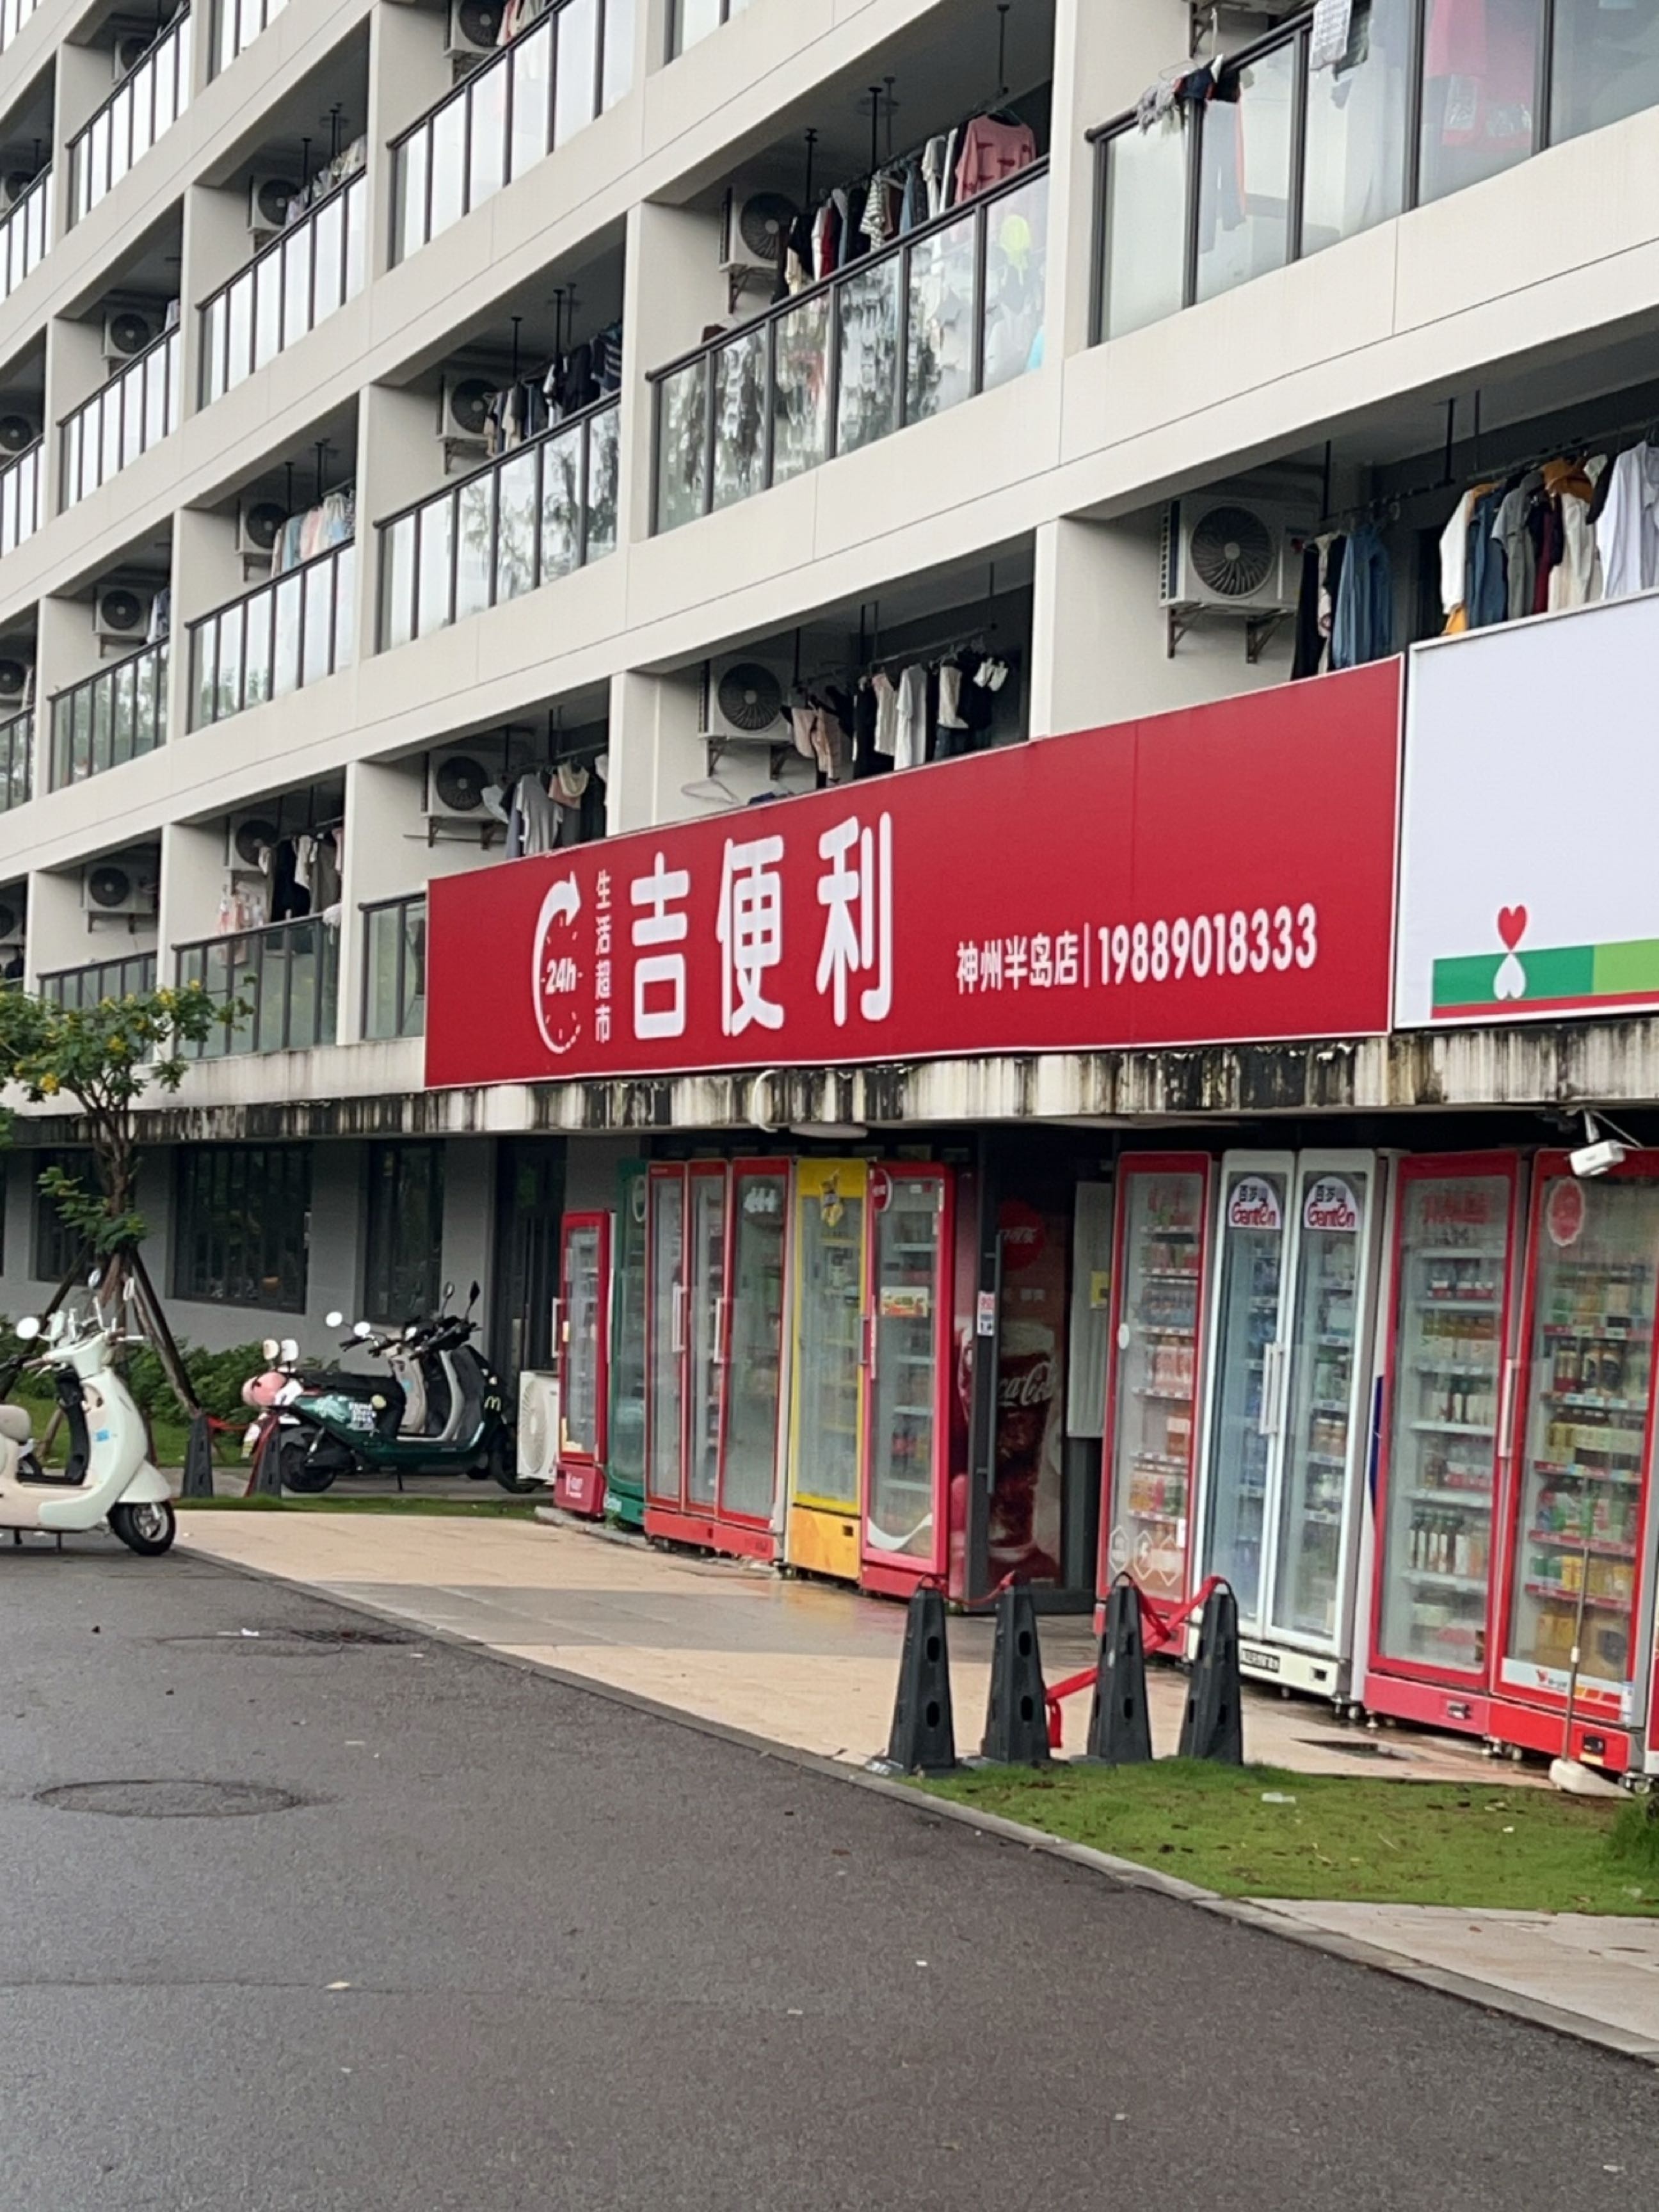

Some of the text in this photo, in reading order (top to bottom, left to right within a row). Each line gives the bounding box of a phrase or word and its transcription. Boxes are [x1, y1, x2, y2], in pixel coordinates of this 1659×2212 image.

[545, 957, 577, 995] 24h
[595, 869, 613, 1045] 生活超市
[630, 812, 892, 1040] 吉便利
[956, 902, 1318, 995] 神州半岛店 19889018333
